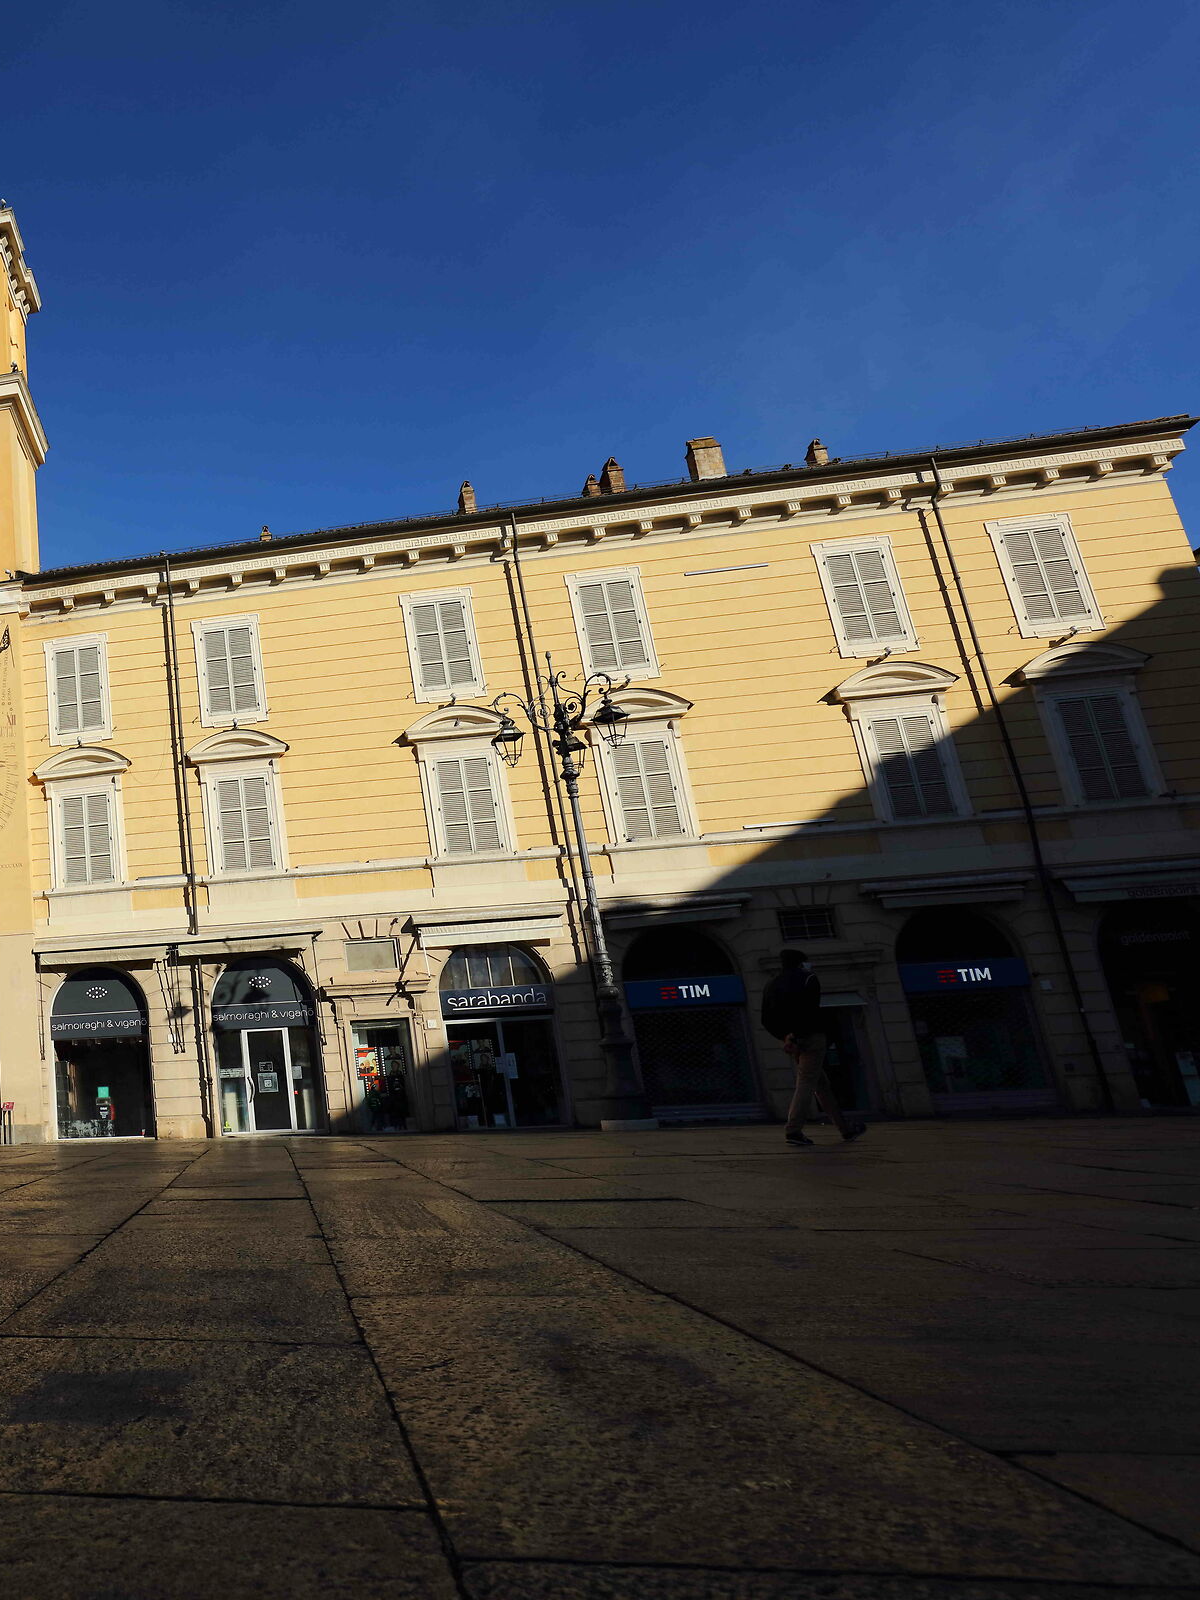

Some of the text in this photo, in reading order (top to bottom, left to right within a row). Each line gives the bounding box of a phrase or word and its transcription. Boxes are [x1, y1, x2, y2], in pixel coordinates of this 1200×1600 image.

[957, 968, 992, 982] TIM
[447, 988, 546, 1007] sarabanda
[678, 984, 710, 998] TIM
[213, 1011, 270, 1021] salmoiraghi
[271, 1010, 279, 1018] &
[51, 1021, 105, 1031] salmoiraghi
